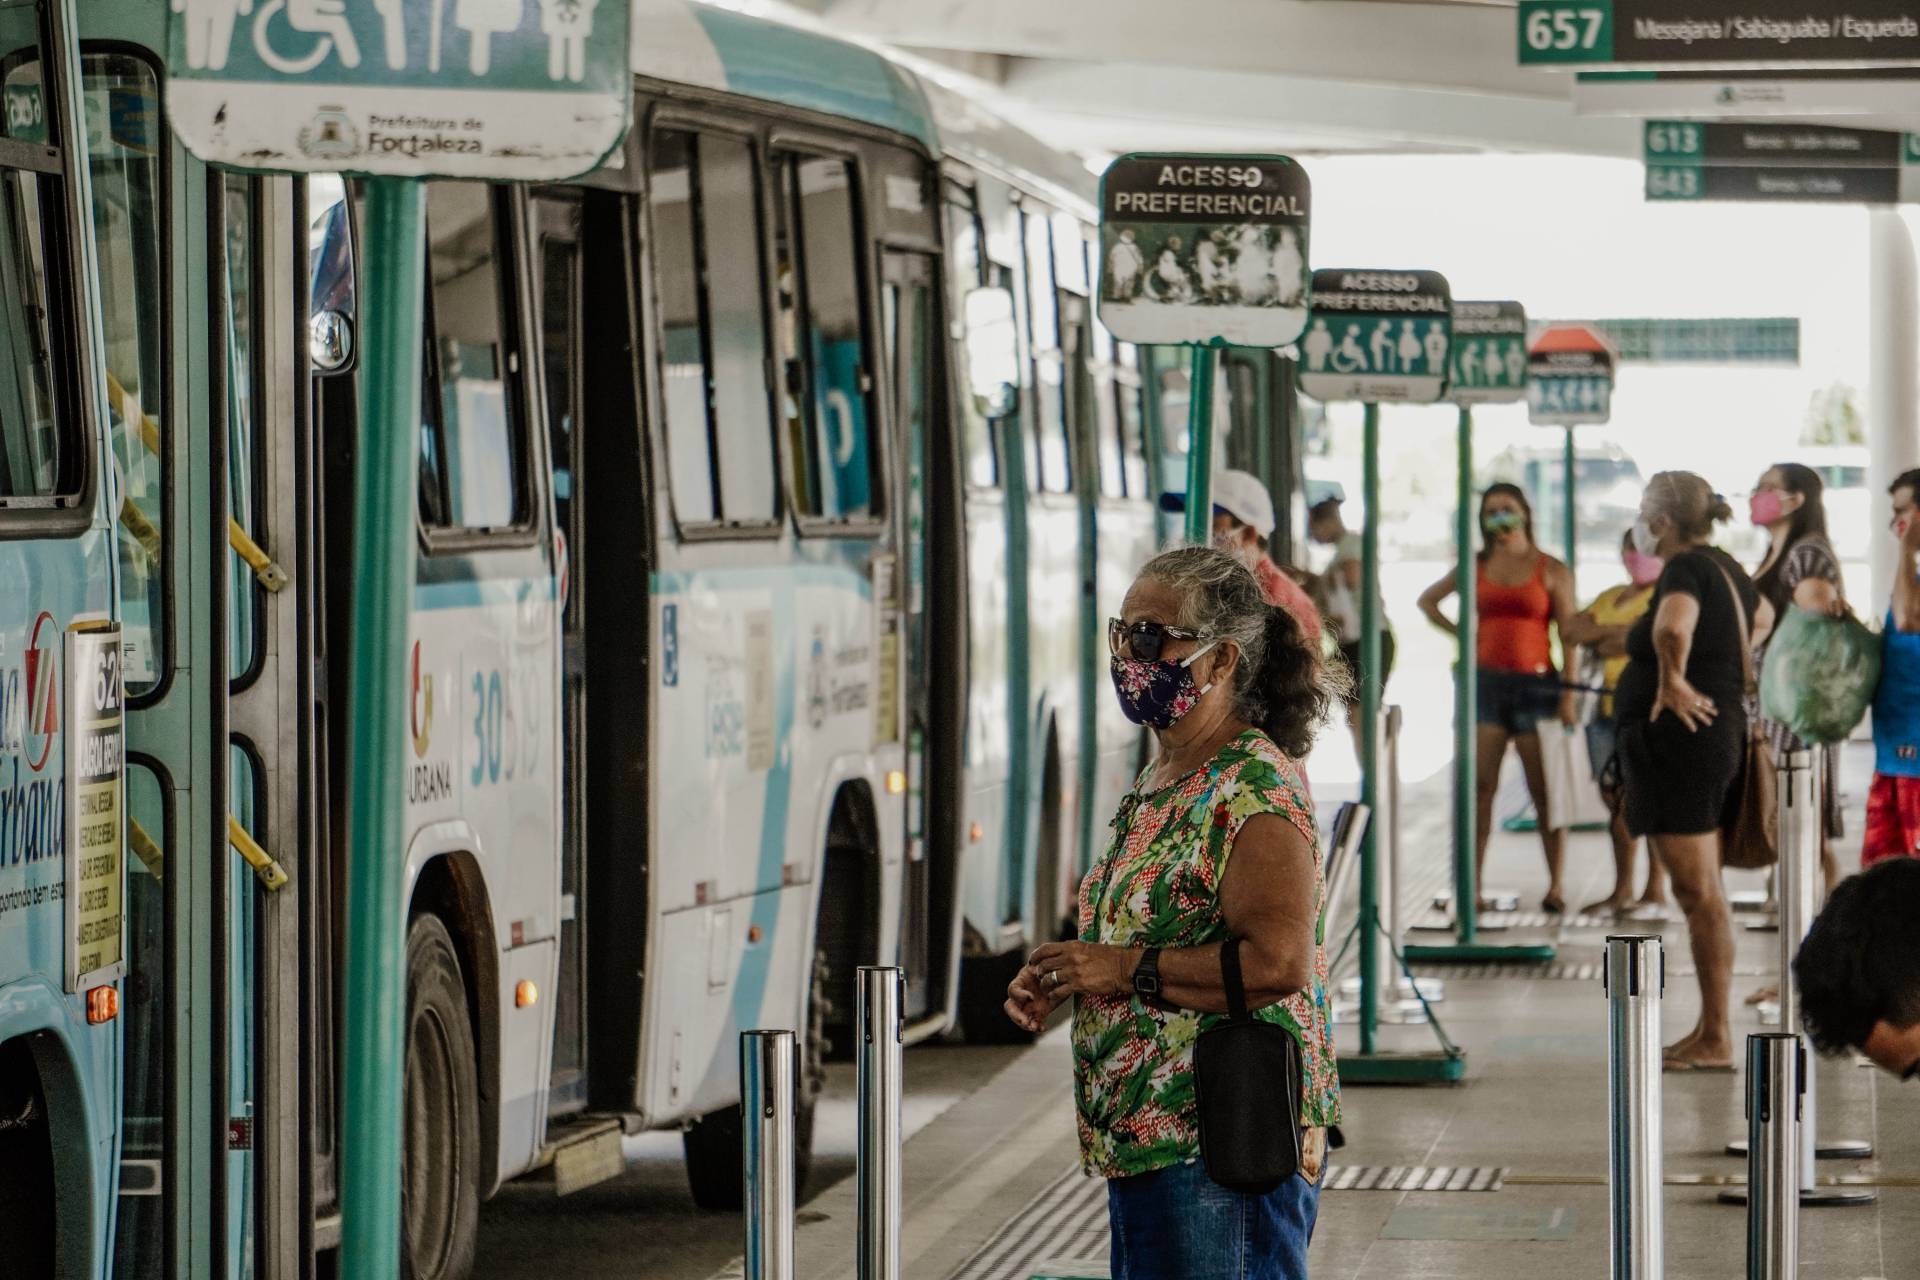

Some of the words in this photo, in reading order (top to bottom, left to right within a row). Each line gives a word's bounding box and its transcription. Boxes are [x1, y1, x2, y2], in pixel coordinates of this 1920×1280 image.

[1526, 9, 1604, 50] 657
[1634, 16, 1722, 45] Messejana
[1844, 14, 1919, 42] Esquerda
[370, 115, 457, 129] Prefeitura
[463, 117, 483, 131] de
[369, 133, 481, 154] Fortaleza
[1157, 165, 1263, 188] ACESSO
[1114, 192, 1305, 217] PREFERENCIAL
[1342, 273, 1419, 292] ACESSO
